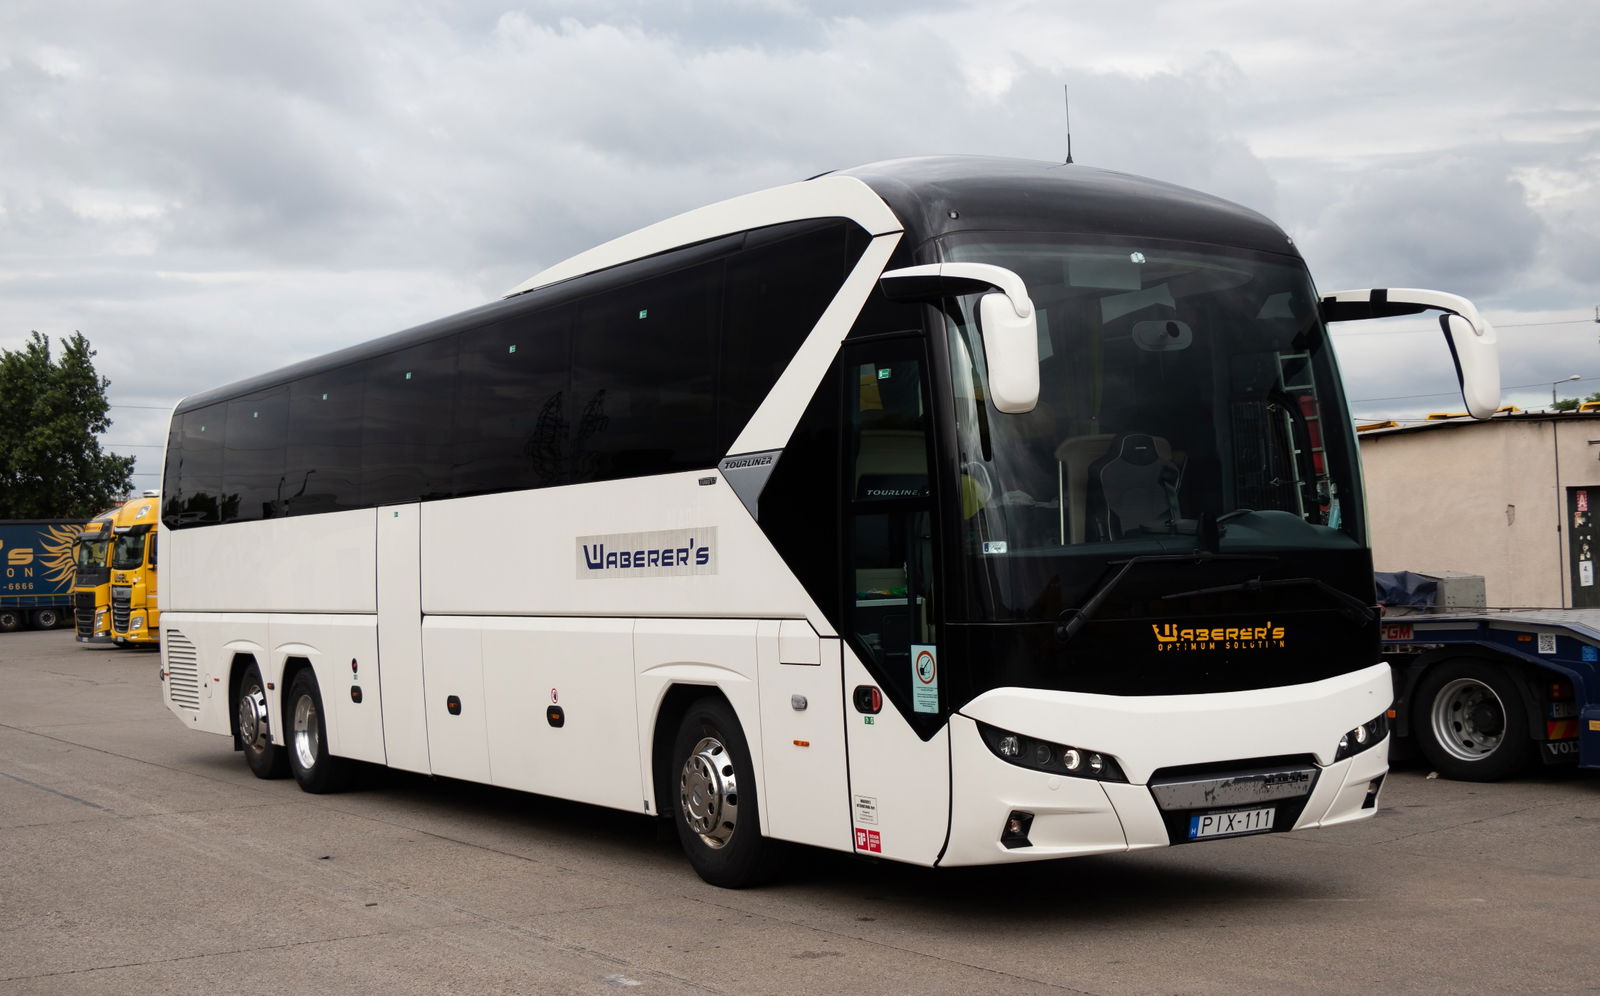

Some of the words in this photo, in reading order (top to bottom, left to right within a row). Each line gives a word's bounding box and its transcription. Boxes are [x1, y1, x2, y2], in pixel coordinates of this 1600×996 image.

[724, 456, 773, 470] TOURLINER
[867, 489, 929, 497] TOURLINE
[583, 537, 709, 570] WABERER'S
[1152, 621, 1285, 642] WABERER'S
[1158, 642, 1215, 652] OPTIMUM
[1201, 810, 1270, 834] PIX-111
